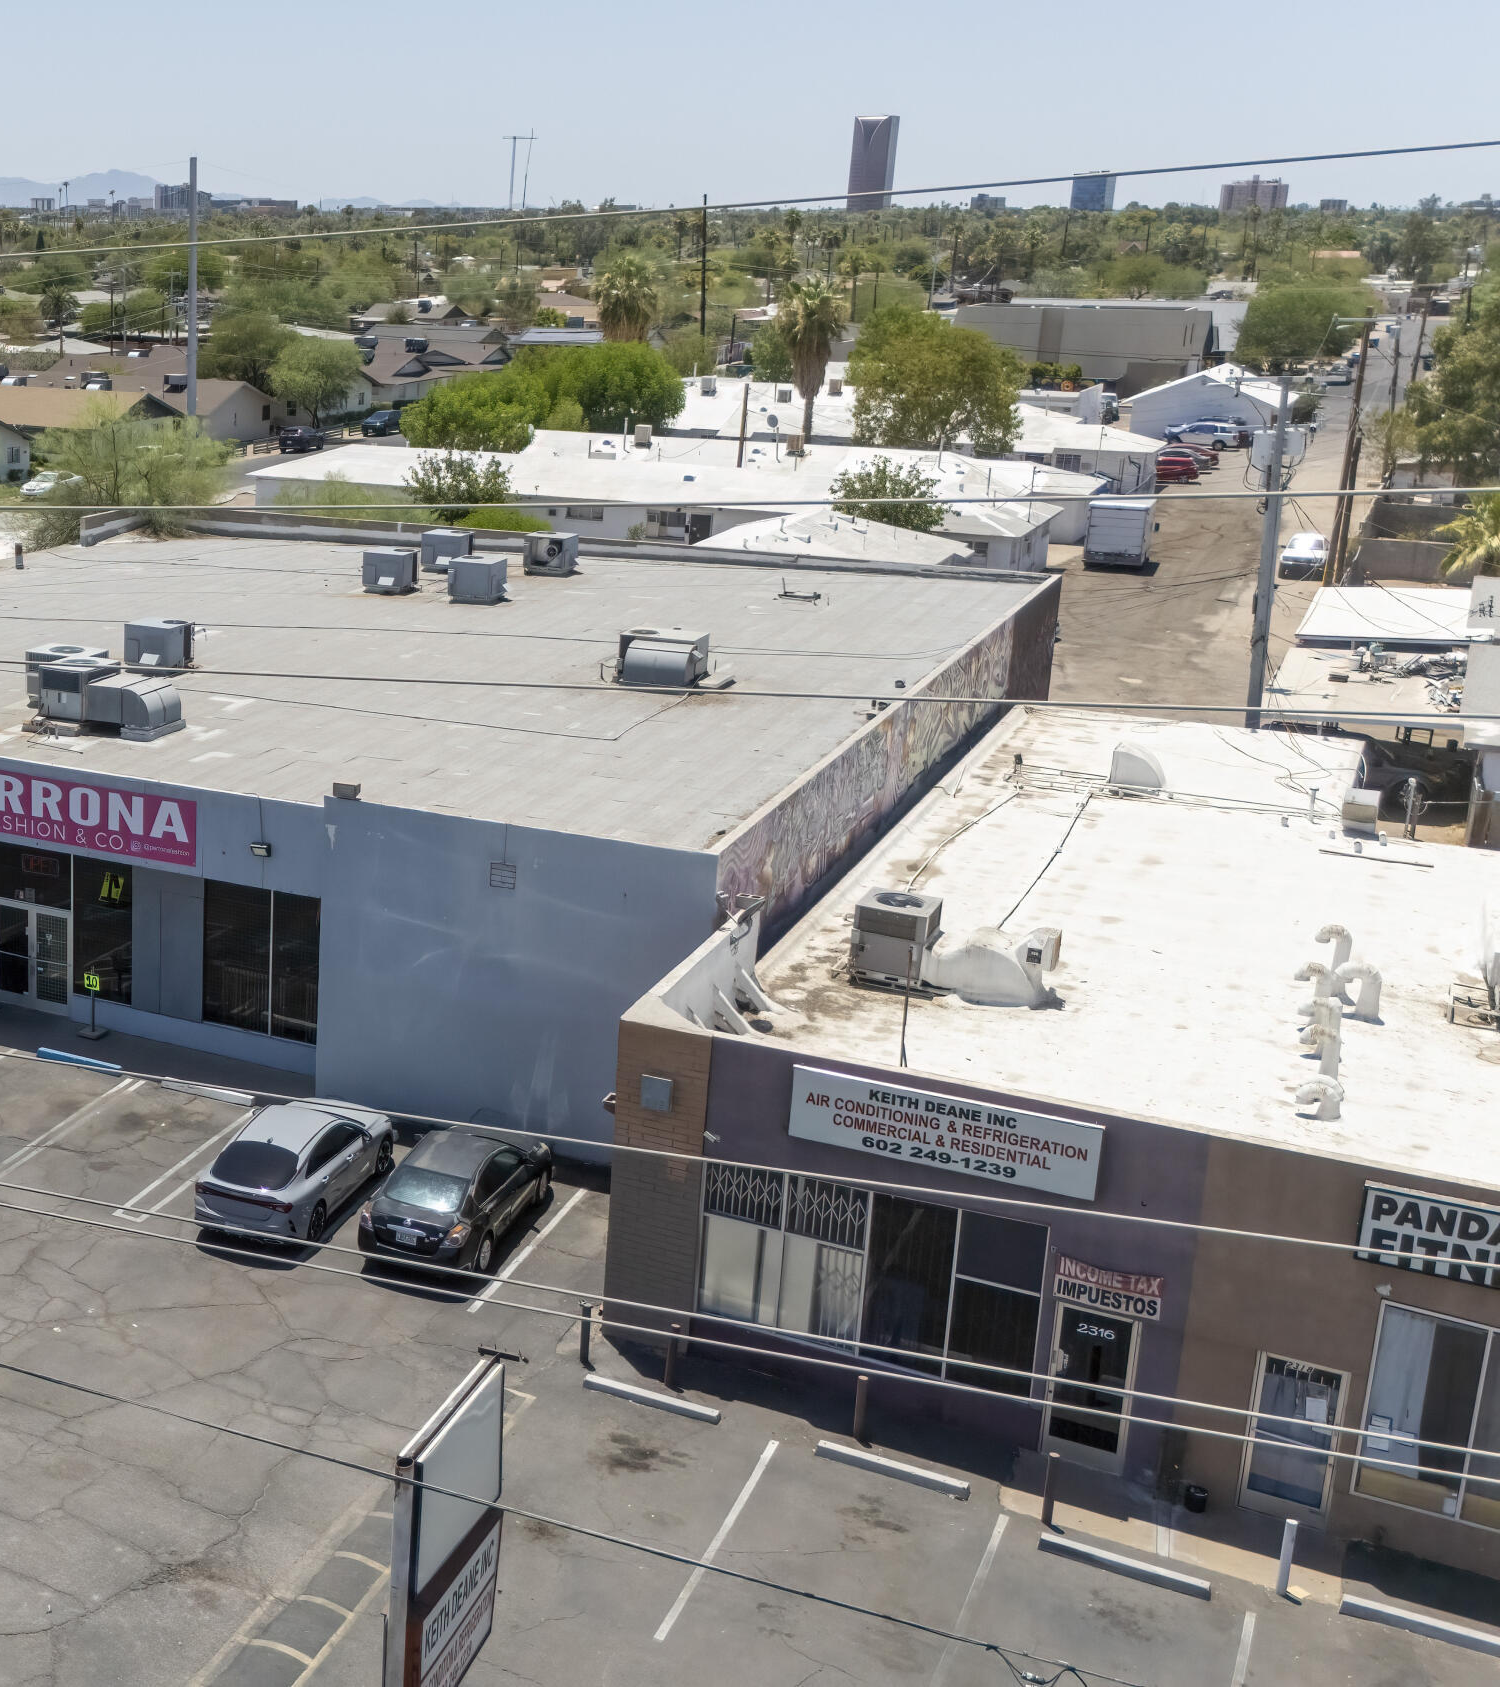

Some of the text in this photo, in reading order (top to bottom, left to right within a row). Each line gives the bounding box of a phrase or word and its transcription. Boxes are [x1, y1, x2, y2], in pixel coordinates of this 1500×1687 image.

[75, 828, 88, 845] &
[805, 1092, 1088, 1162] AIR CONDITIONING & REFRIGERATION
[868, 1089, 1018, 1130] KEITH DEANE INC
[832, 1114, 1052, 1171] COMMERCIAL & RESIDENTIAL
[862, 1136, 1018, 1180] 602 249-1239
[1060, 1256, 1160, 1296] INCOME TAX
[1057, 1278, 1158, 1316] IMPUESTOS
[1076, 1322, 1116, 1340] 2316
[1285, 1361, 1314, 1374] 2318
[424, 1599, 450, 1658] KEITH
[452, 1558, 480, 1621] DEANE
